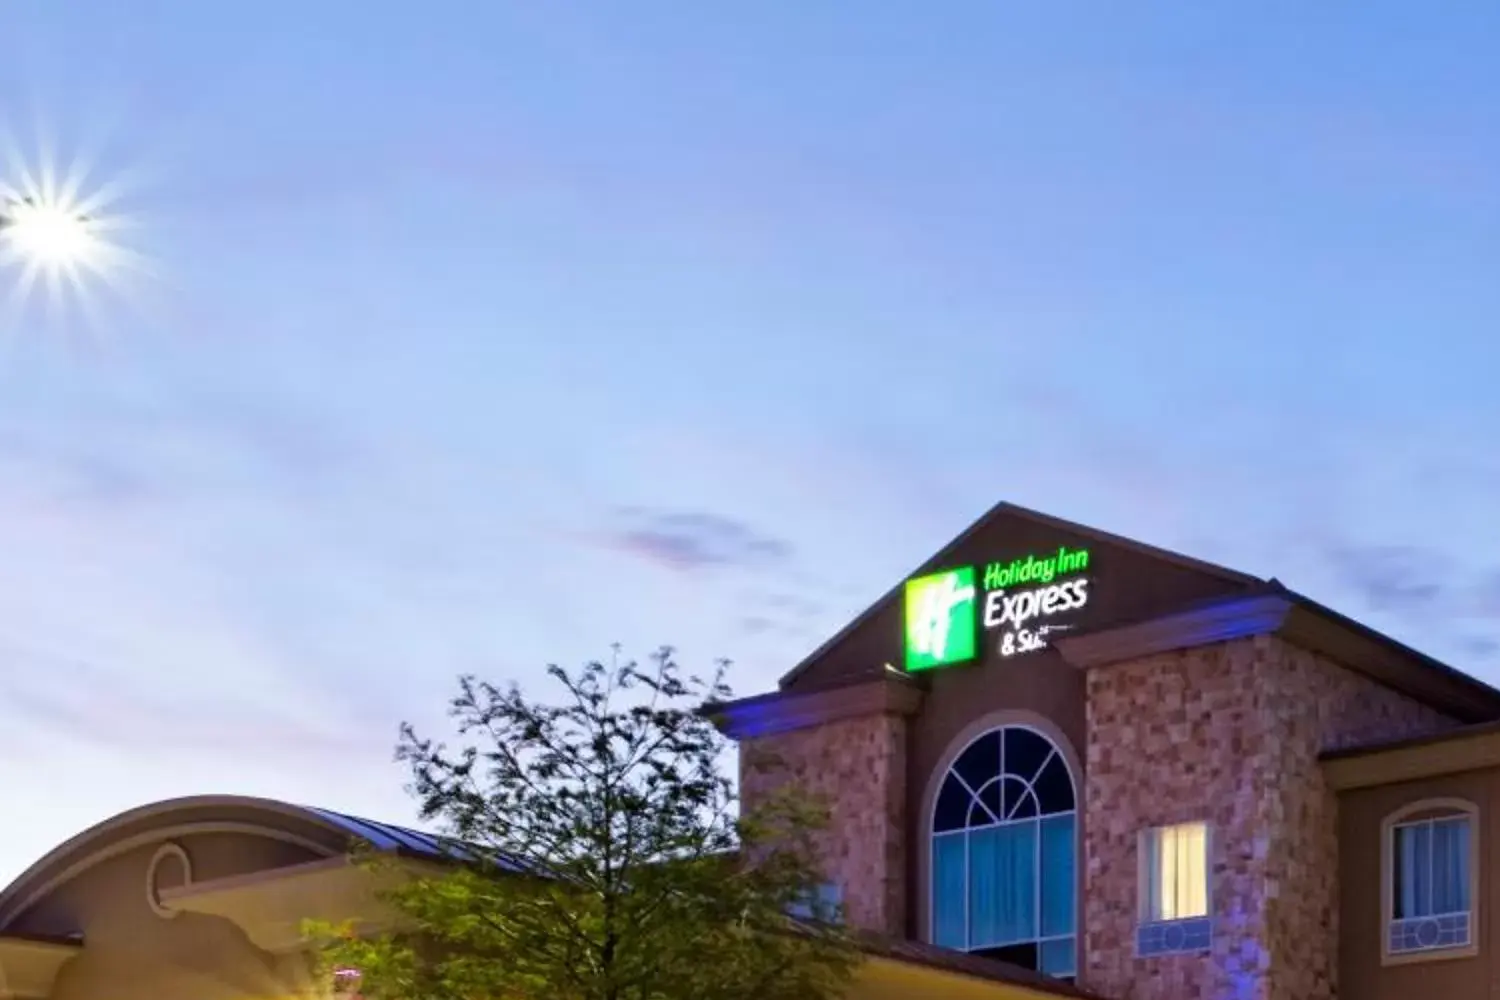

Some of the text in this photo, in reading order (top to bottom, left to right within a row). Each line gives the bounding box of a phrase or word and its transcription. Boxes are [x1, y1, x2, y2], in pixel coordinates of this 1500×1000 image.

[984, 547, 1089, 591] Holiday Inn
[983, 578, 1089, 629] Express
[1001, 632, 1015, 656] &
